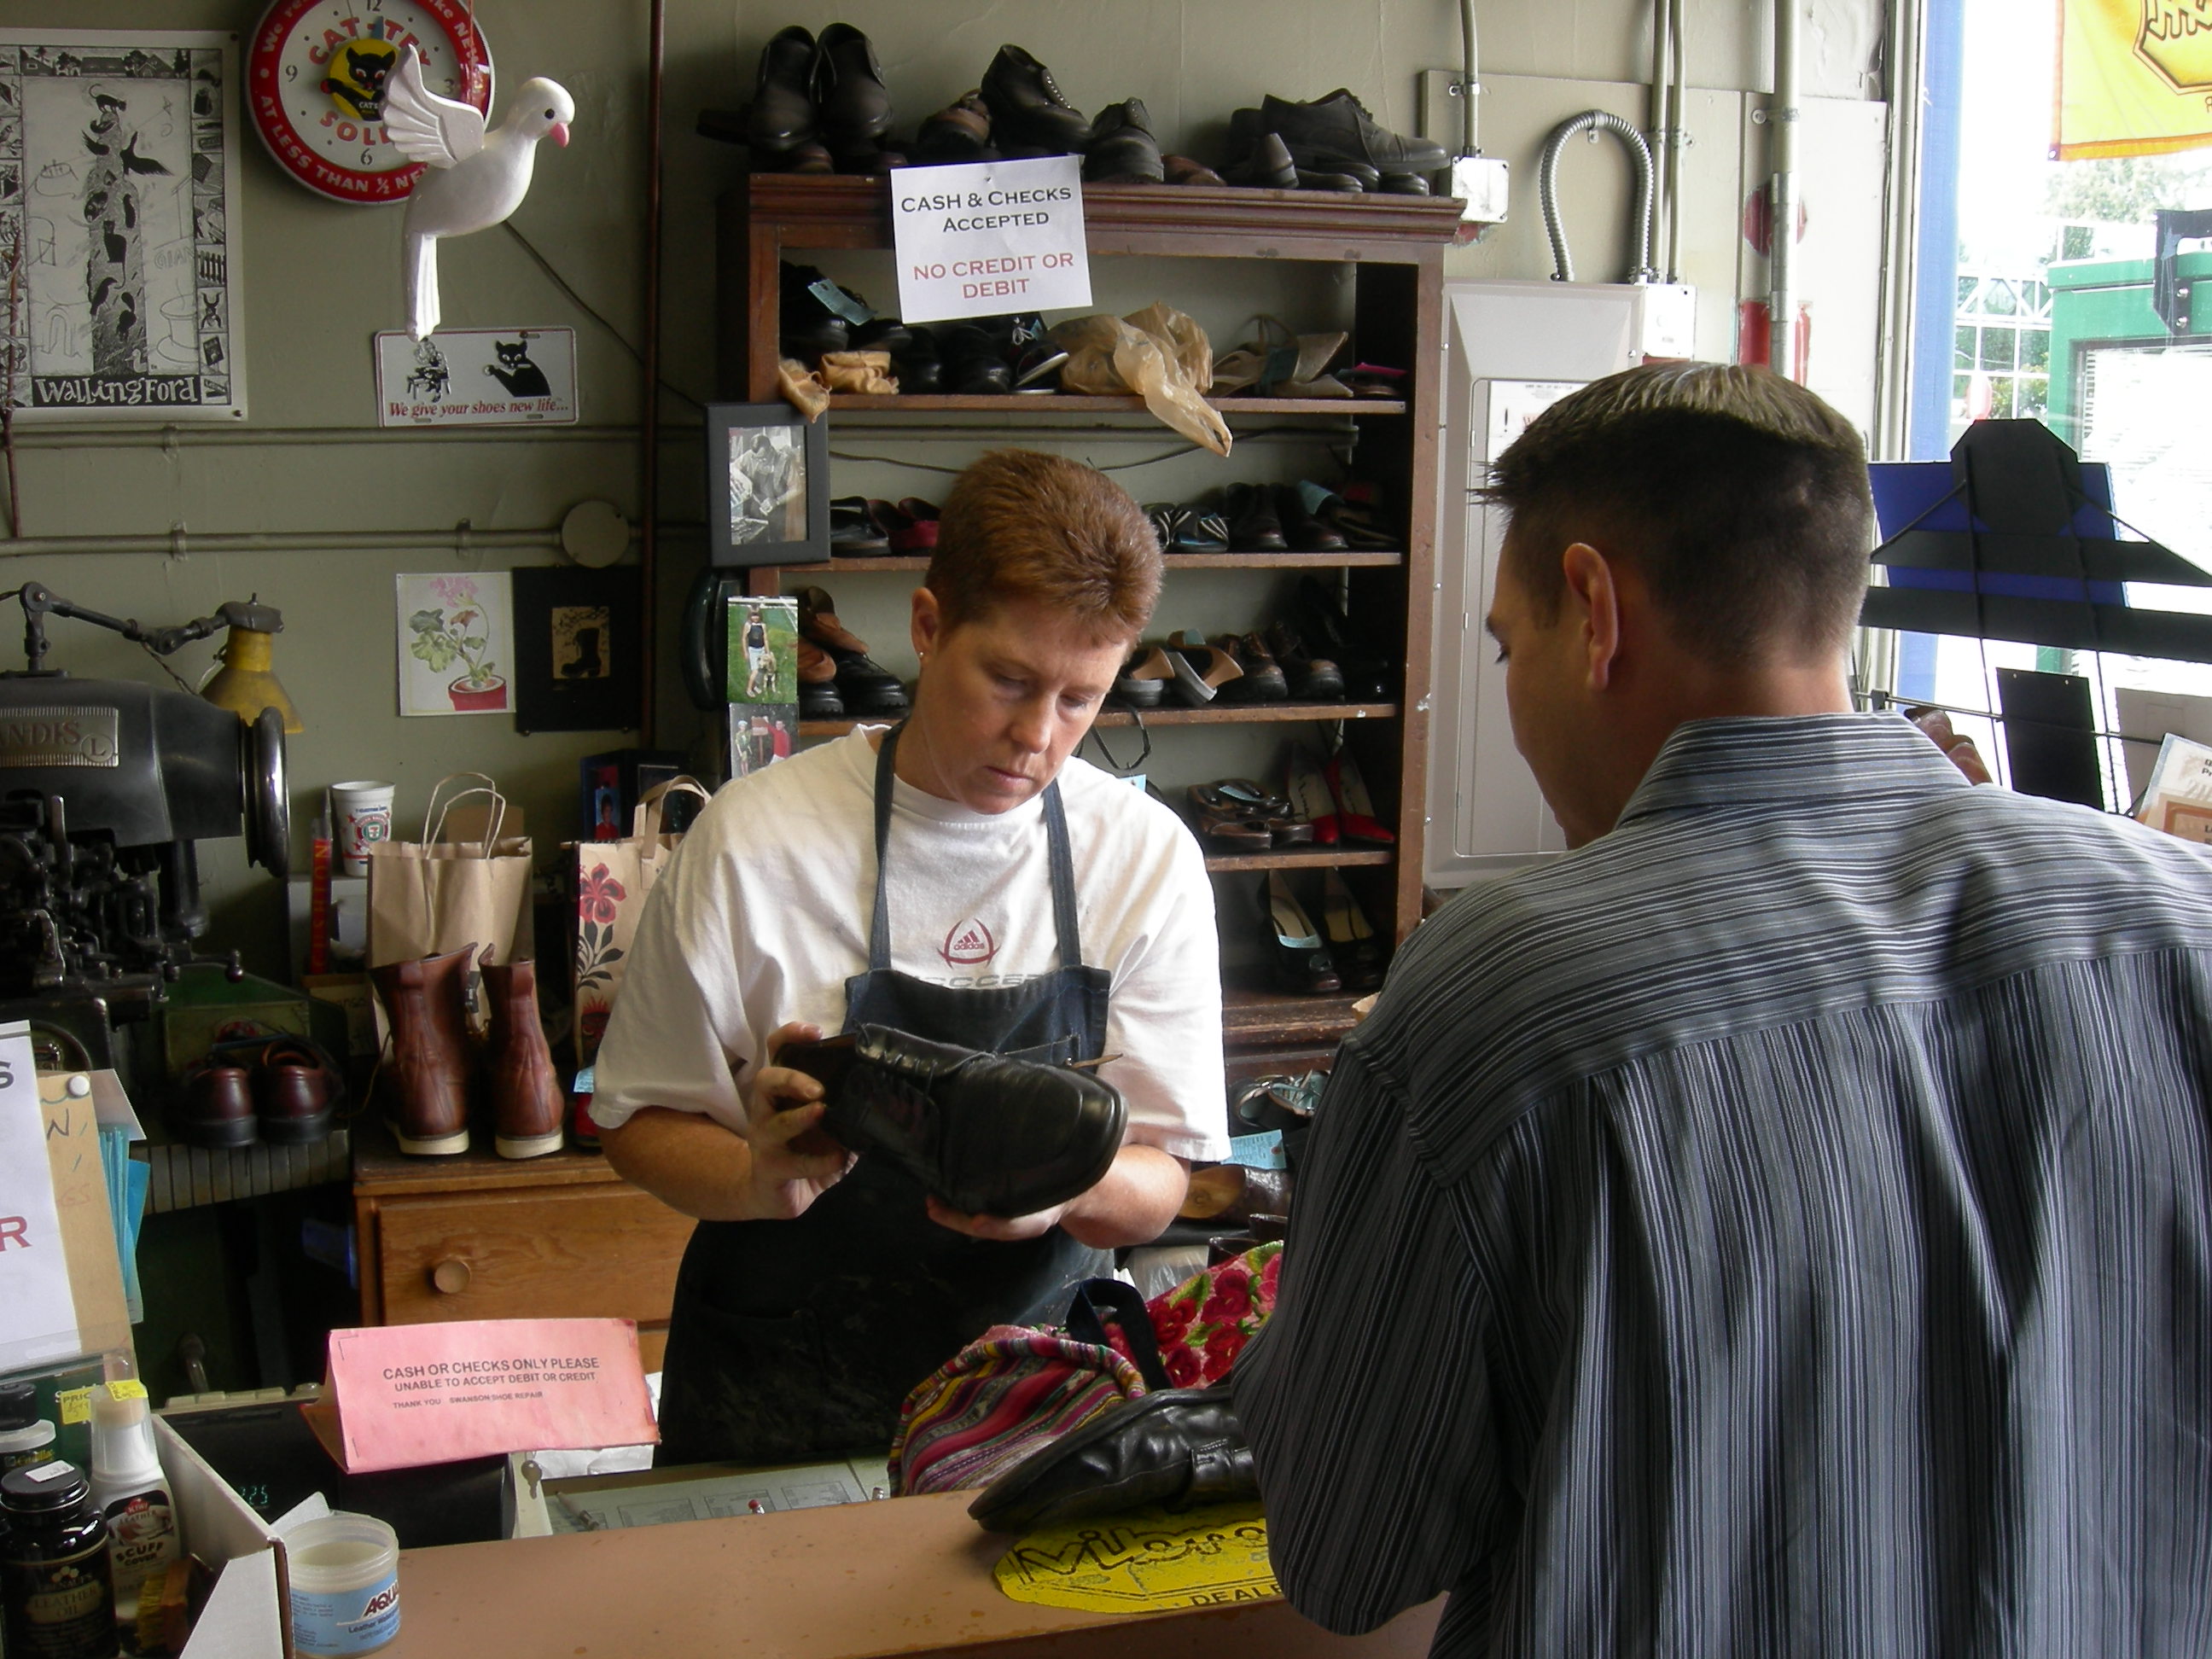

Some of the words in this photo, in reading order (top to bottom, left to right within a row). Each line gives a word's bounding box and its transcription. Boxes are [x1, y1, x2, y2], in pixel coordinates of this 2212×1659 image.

[285, 65, 298, 82] 9
[260, 96, 278, 118] AT
[271, 125, 312, 169] LESS
[316, 165, 369, 193] THAN
[360, 148, 373, 166] 6
[901, 194, 961, 212] CASH
[967, 193, 983, 207] &
[913, 263, 946, 281] NO
[952, 255, 1035, 277] CREDIT
[1042, 253, 1074, 269] OR
[963, 278, 1030, 300] DEBIT
[389, 402, 410, 417] We
[410, 403, 438, 419] give
[439, 404, 469, 419] your
[471, 399, 506, 414] shoes
[511, 401, 533, 412] new
[383, 1365, 426, 1381] CASH
[428, 1363, 450, 1376] OR
[452, 1359, 510, 1374] CHECKS
[513, 1358, 548, 1371] ONLY
[550, 1357, 600, 1370] PLEASE
[394, 1381, 443, 1393] UNABLE
[445, 1377, 460, 1388] TO
[463, 1375, 505, 1387] ACCEPT
[509, 1372, 540, 1384] DEBIT
[543, 1372, 557, 1382] OR
[559, 1371, 597, 1382] CREDIT
[393, 1400, 422, 1410] THANK
[424, 1398, 441, 1406] YOU
[449, 1394, 490, 1405] SWANSON
[515, 1391, 543, 1400] REPAIR
[116, 1541, 164, 1562] SCUFF
[125, 1553, 158, 1566] COVER
